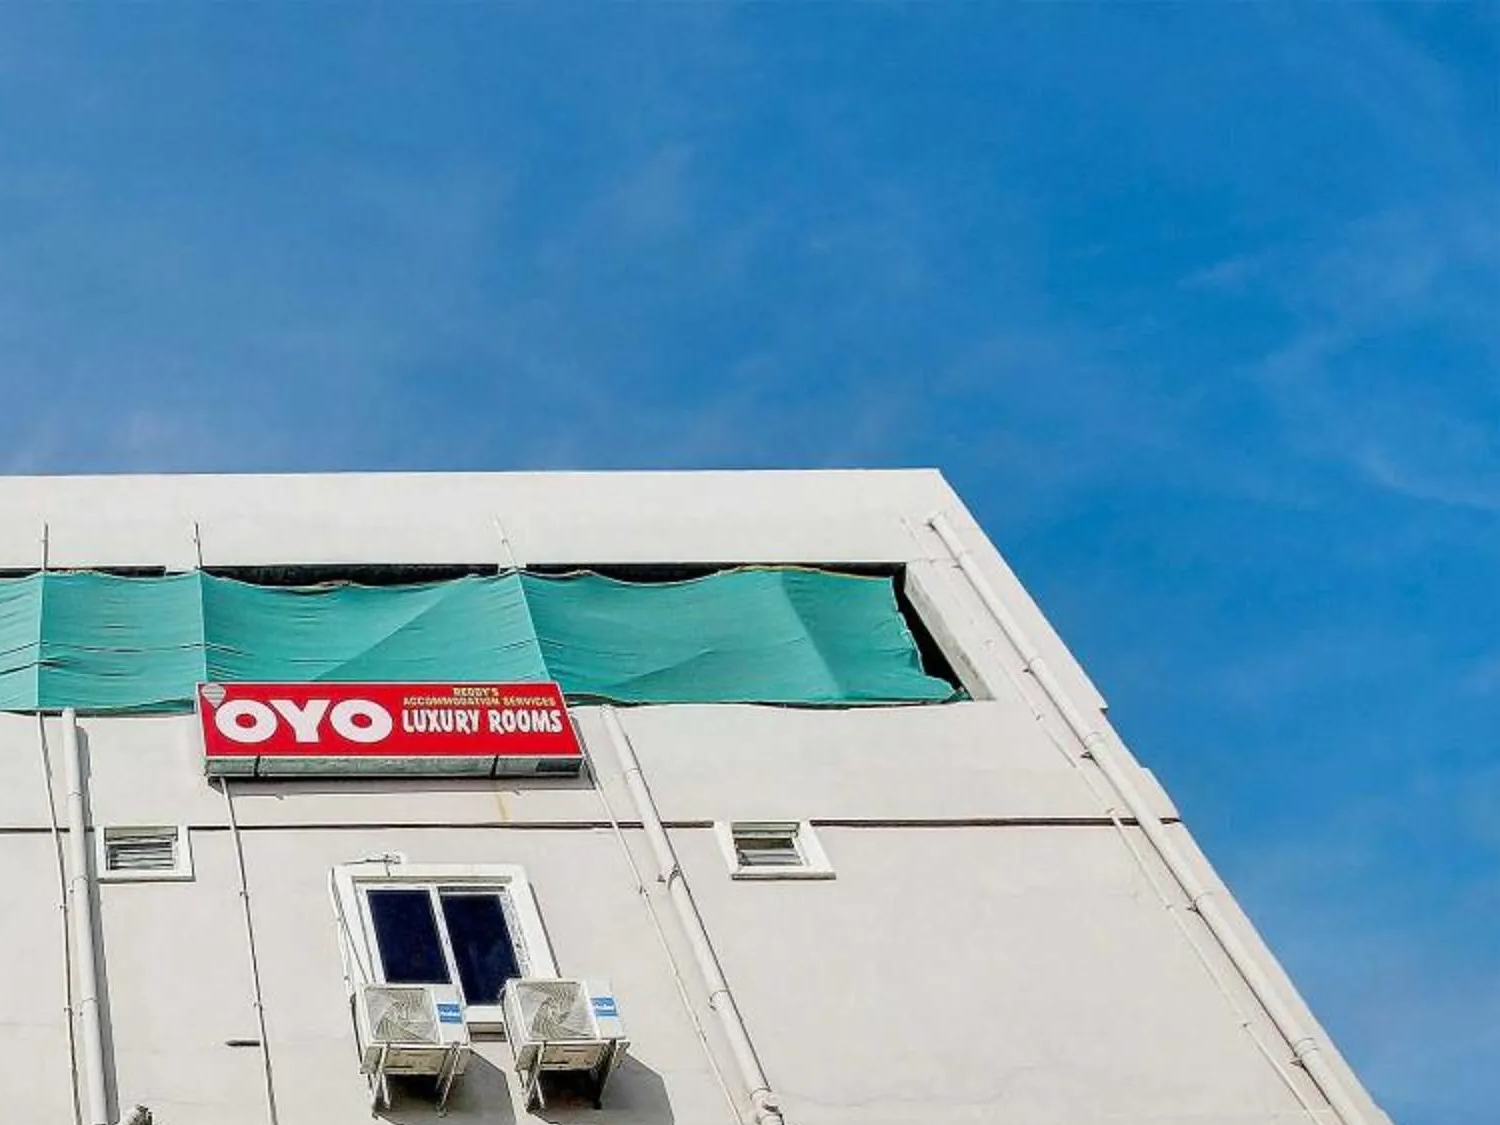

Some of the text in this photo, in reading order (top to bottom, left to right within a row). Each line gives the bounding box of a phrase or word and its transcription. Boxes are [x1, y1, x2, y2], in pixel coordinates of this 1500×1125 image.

[503, 697, 556, 706] SERVICES
[215, 698, 393, 744] OYO
[402, 709, 563, 734] LUXURY ROOMS
